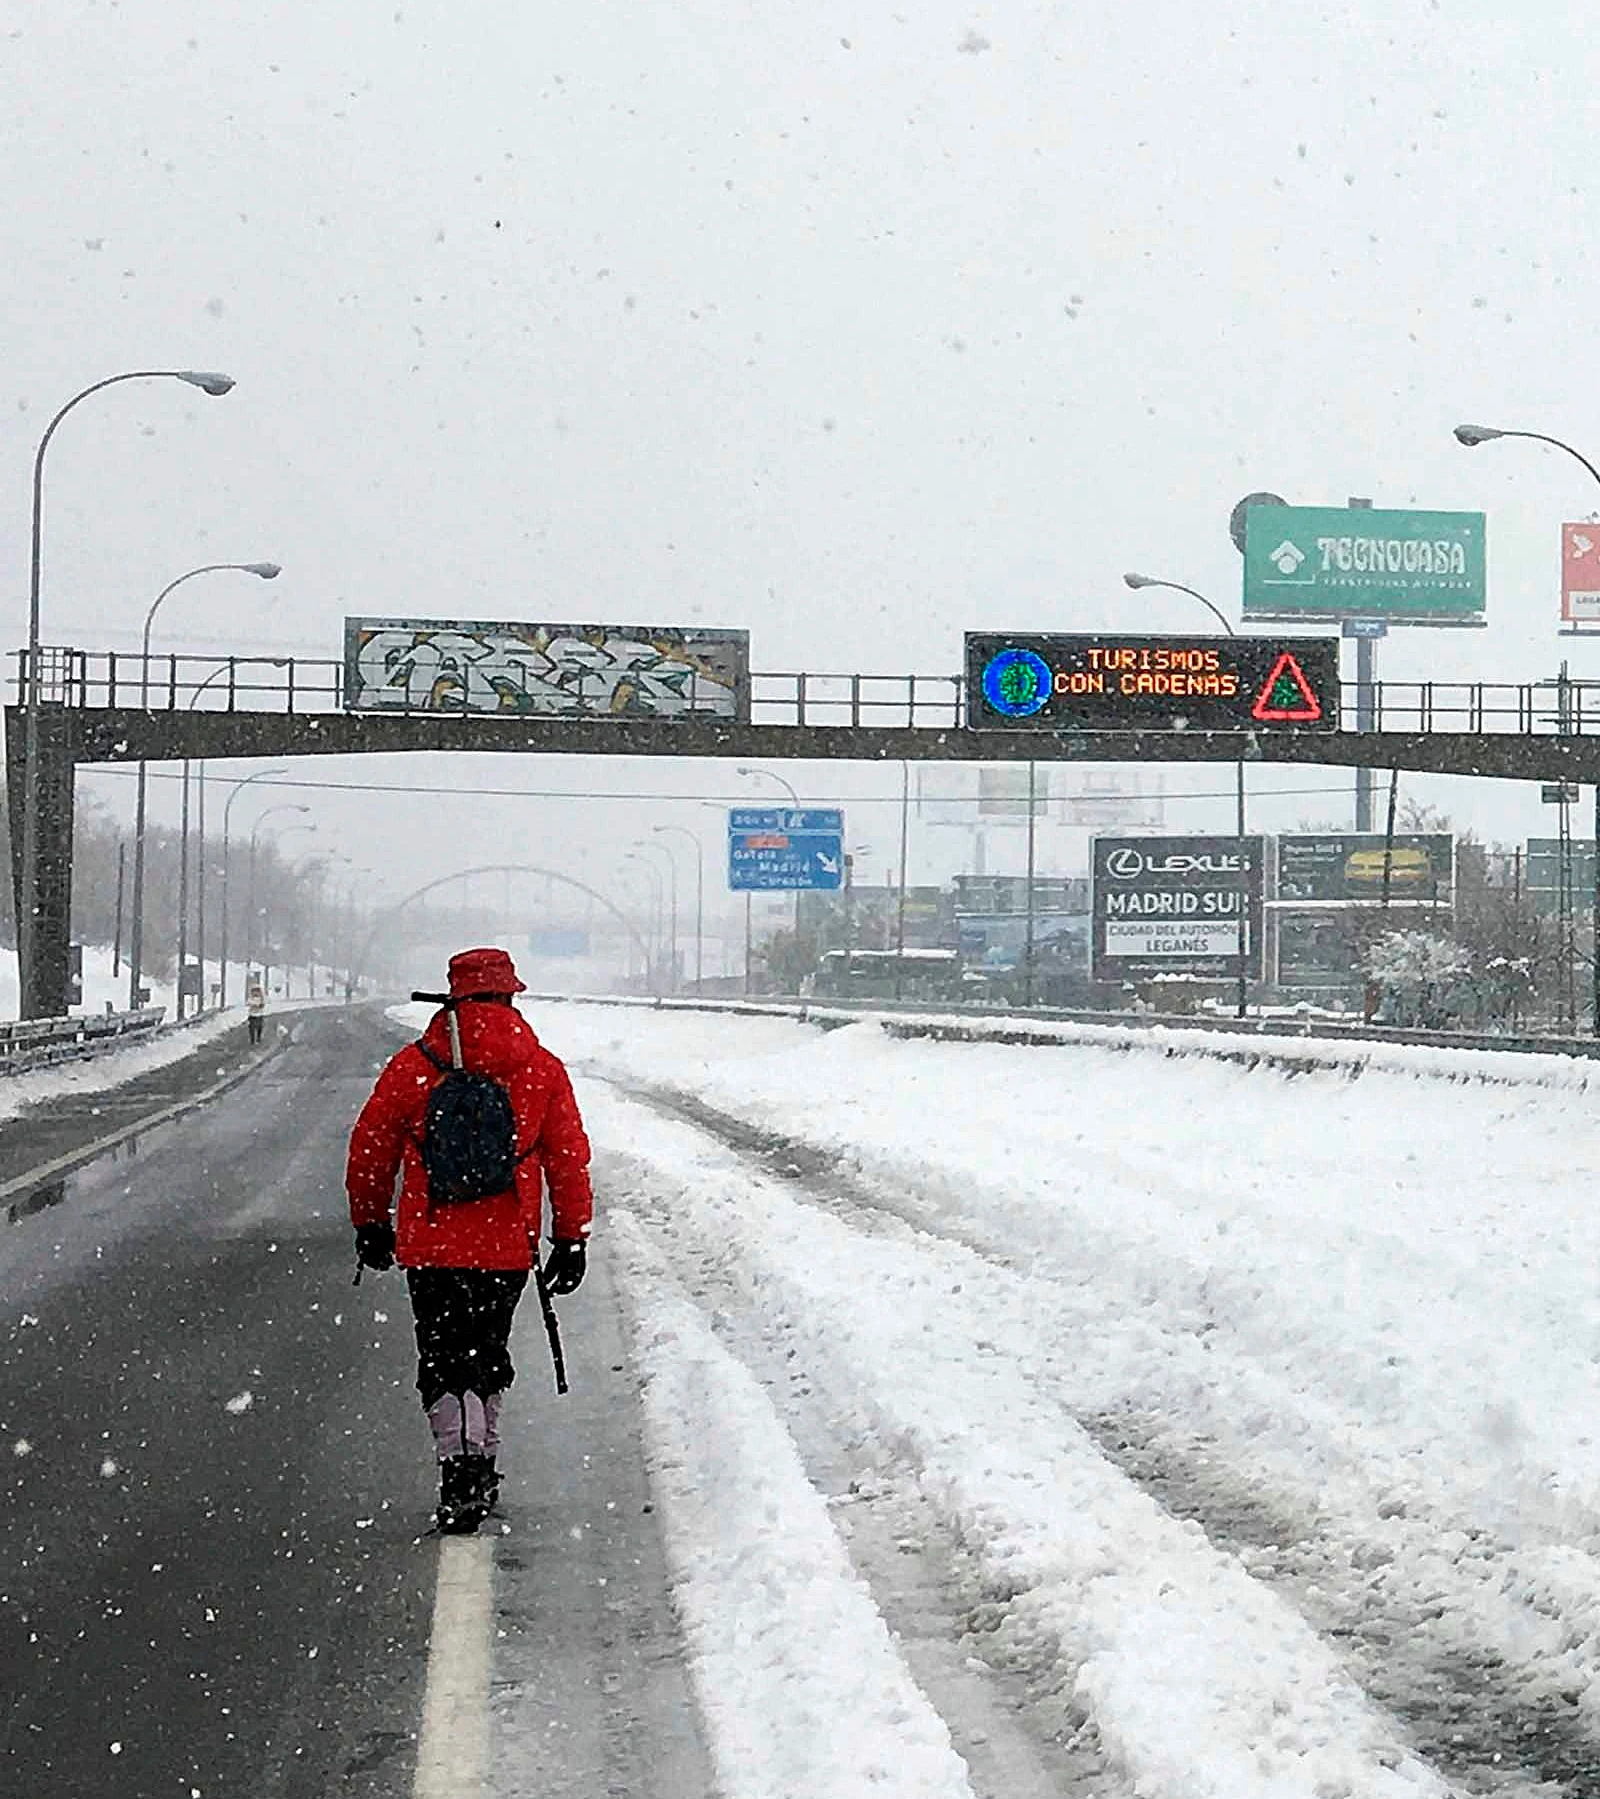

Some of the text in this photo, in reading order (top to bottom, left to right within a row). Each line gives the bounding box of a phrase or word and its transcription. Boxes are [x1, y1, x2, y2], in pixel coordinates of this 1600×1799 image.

[1317, 537, 1466, 575] TECNOCASA
[1088, 649, 1220, 671] TURISMOS
[1053, 672, 1236, 697] CON CADENAS
[1146, 854, 1252, 872] LEXUS
[1106, 893, 1198, 915] MADRID
[1109, 925, 1154, 935] CIUDAD
[1156, 925, 1176, 935] DEL
[1146, 937, 1209, 951] LEGANÉS
